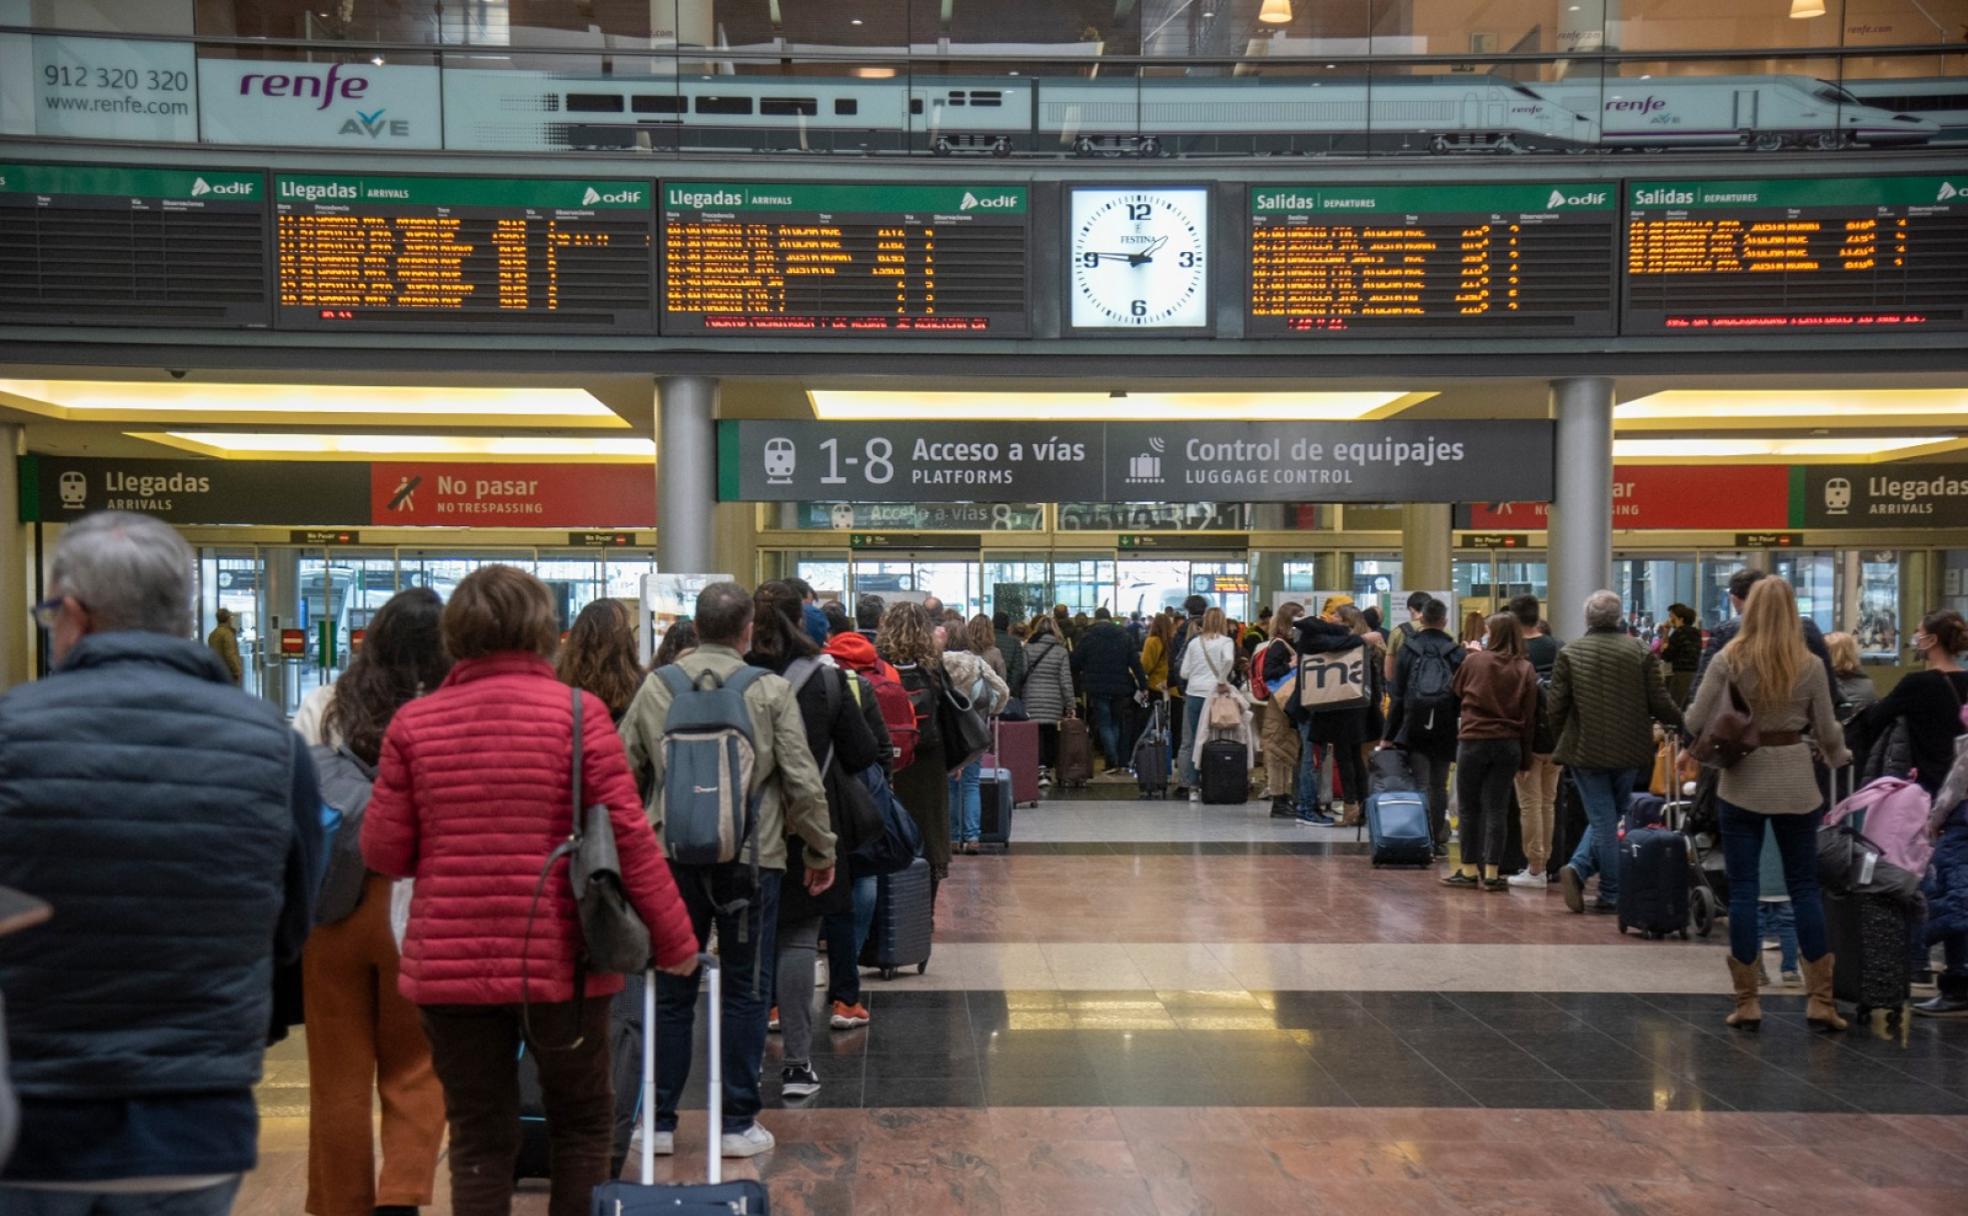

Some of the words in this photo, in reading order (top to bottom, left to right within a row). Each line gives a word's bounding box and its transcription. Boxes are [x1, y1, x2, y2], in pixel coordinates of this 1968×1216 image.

[44, 65, 87, 87] 912
[97, 67, 139, 89] 320
[147, 70, 188, 92] 320
[239, 60, 369, 110] renfe
[45, 95, 189, 116] www.renfe.com
[1511, 104, 1543, 115] renfe
[1605, 95, 1666, 115] renfe
[337, 109, 409, 138] AVE
[213, 182, 254, 195] adif
[281, 181, 357, 201] Llegadas
[367, 189, 409, 199] ARRIVALS
[602, 191, 642, 203] adif
[1635, 189, 1694, 205] Salidas
[1704, 193, 1758, 203] DEPARTURES
[669, 190, 742, 208] Llegadas
[752, 196, 793, 205] ARRIVALS
[980, 195, 1019, 207] adif
[1256, 193, 1314, 210] Salidas
[1323, 199, 1376, 208] DEPARTURES
[1567, 192, 1607, 206] adif
[1126, 203, 1152, 221] 12
[1120, 236, 1157, 244] FESTINA
[1083, 251, 1099, 268] 9
[1178, 251, 1194, 268] 3
[1131, 299, 1147, 317] 6
[912, 438, 999, 462] Acceso
[1008, 443, 1023, 462] a
[1032, 435, 1085, 462] vías
[1185, 437, 1280, 462] Control
[1291, 437, 1323, 462] de
[1333, 435, 1465, 467] equipajes
[818, 436, 894, 484] 1-8
[105, 471, 211, 497] Llegadas
[912, 469, 1013, 484] PLATFORMS
[1185, 469, 1269, 484] LUGGAGE
[1273, 469, 1353, 484] CONTROL
[437, 476, 467, 495] No
[476, 480, 538, 500] pasar
[1869, 476, 1968, 501] Llegadas
[107, 499, 173, 511] ARRIVALS
[437, 502, 456, 513] NO
[457, 503, 543, 514] TRESPASSING
[1869, 503, 1933, 514] ARRIVALS
